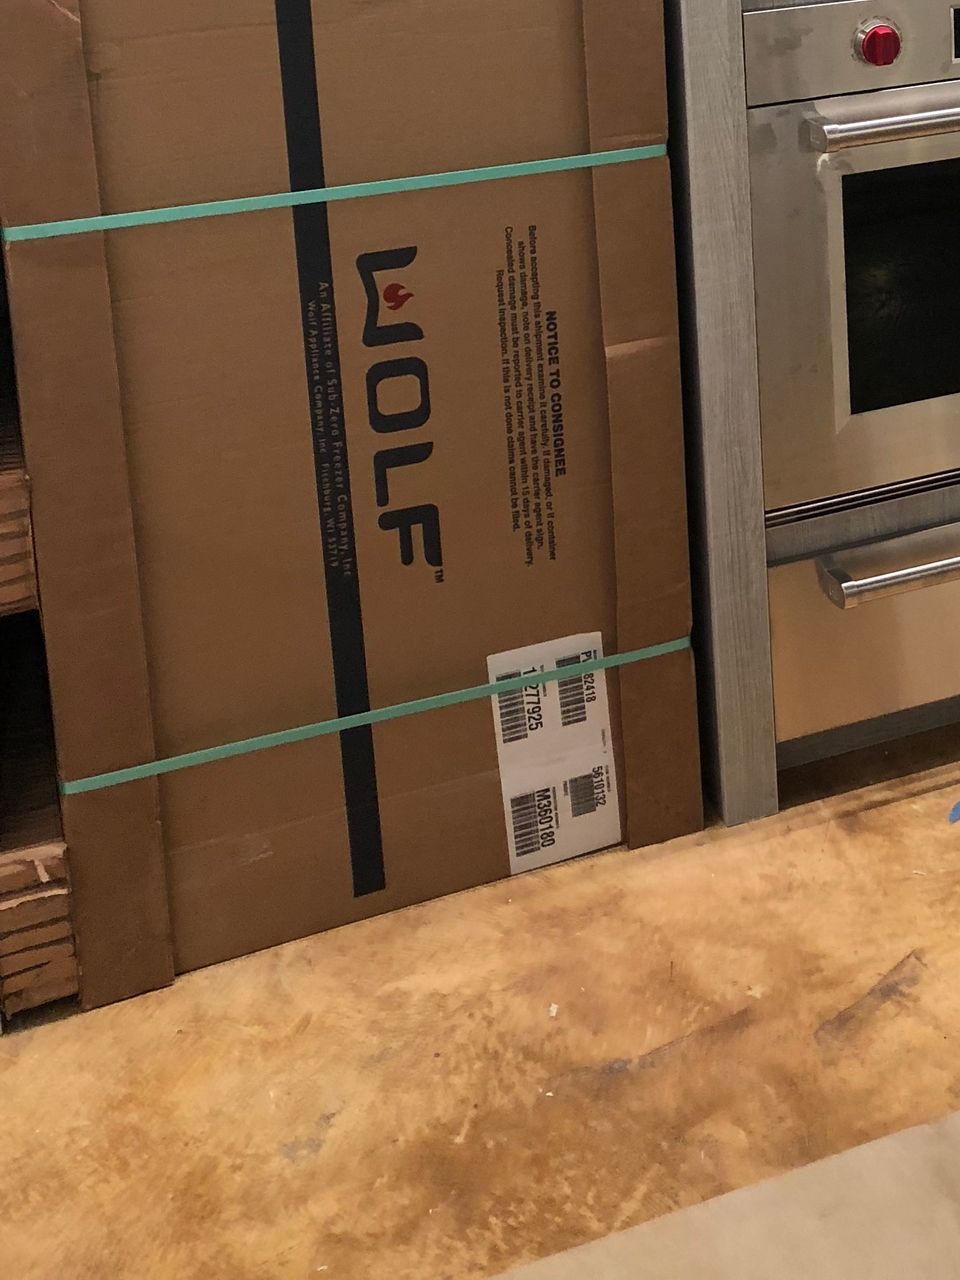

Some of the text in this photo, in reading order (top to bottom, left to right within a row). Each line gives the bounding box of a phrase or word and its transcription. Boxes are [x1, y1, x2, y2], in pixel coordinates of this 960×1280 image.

[505, 227, 515, 273] Concealed
[528, 225, 537, 254] Before
[319, 282, 329, 298] An
[496, 270, 505, 306] Request
[531, 257, 540, 299] accepting
[507, 276, 517, 310] damage
[308, 301, 318, 326] Wolf
[511, 313, 519, 335] must
[534, 302, 542, 318] this
[321, 304, 333, 355] Affiliate
[513, 337, 519, 347] be
[524, 333, 531, 344] on
[533, 321, 544, 361] shipment
[309, 330, 321, 380] Appliance
[325, 362, 334, 373] of
[513, 350, 522, 387] reported
[525, 347, 533, 380] delivery
[516, 389, 522, 398] to
[537, 364, 547, 399] examine
[546, 311, 566, 476] NOTICE TO CONSIGNEE
[327, 379, 340, 435] Sub-Zero
[356, 246, 443, 566] WOLF
[505, 396, 513, 410] not
[527, 383, 535, 413] receipt
[505, 412, 513, 434] done
[516, 401, 524, 429] carrier
[507, 436, 515, 464] claims
[517, 432, 526, 455] agent
[332, 442, 344, 488] Freezer
[520, 458, 528, 483] within
[509, 466, 517, 496] cannot
[522, 487, 529, 495] 15
[533, 472, 541, 499] carrier
[511, 498, 518, 509] be
[522, 498, 530, 518] days
[534, 502, 542, 526] agent
[546, 502, 552, 510] or
[326, 519, 334, 532] WI
[525, 520, 532, 528] of
[548, 520, 556, 560] container
[581, 650, 596, 702] P82418
[523, 667, 543, 730] 1277925
[593, 766, 606, 806] 5610132
[536, 787, 556, 848] M360180
